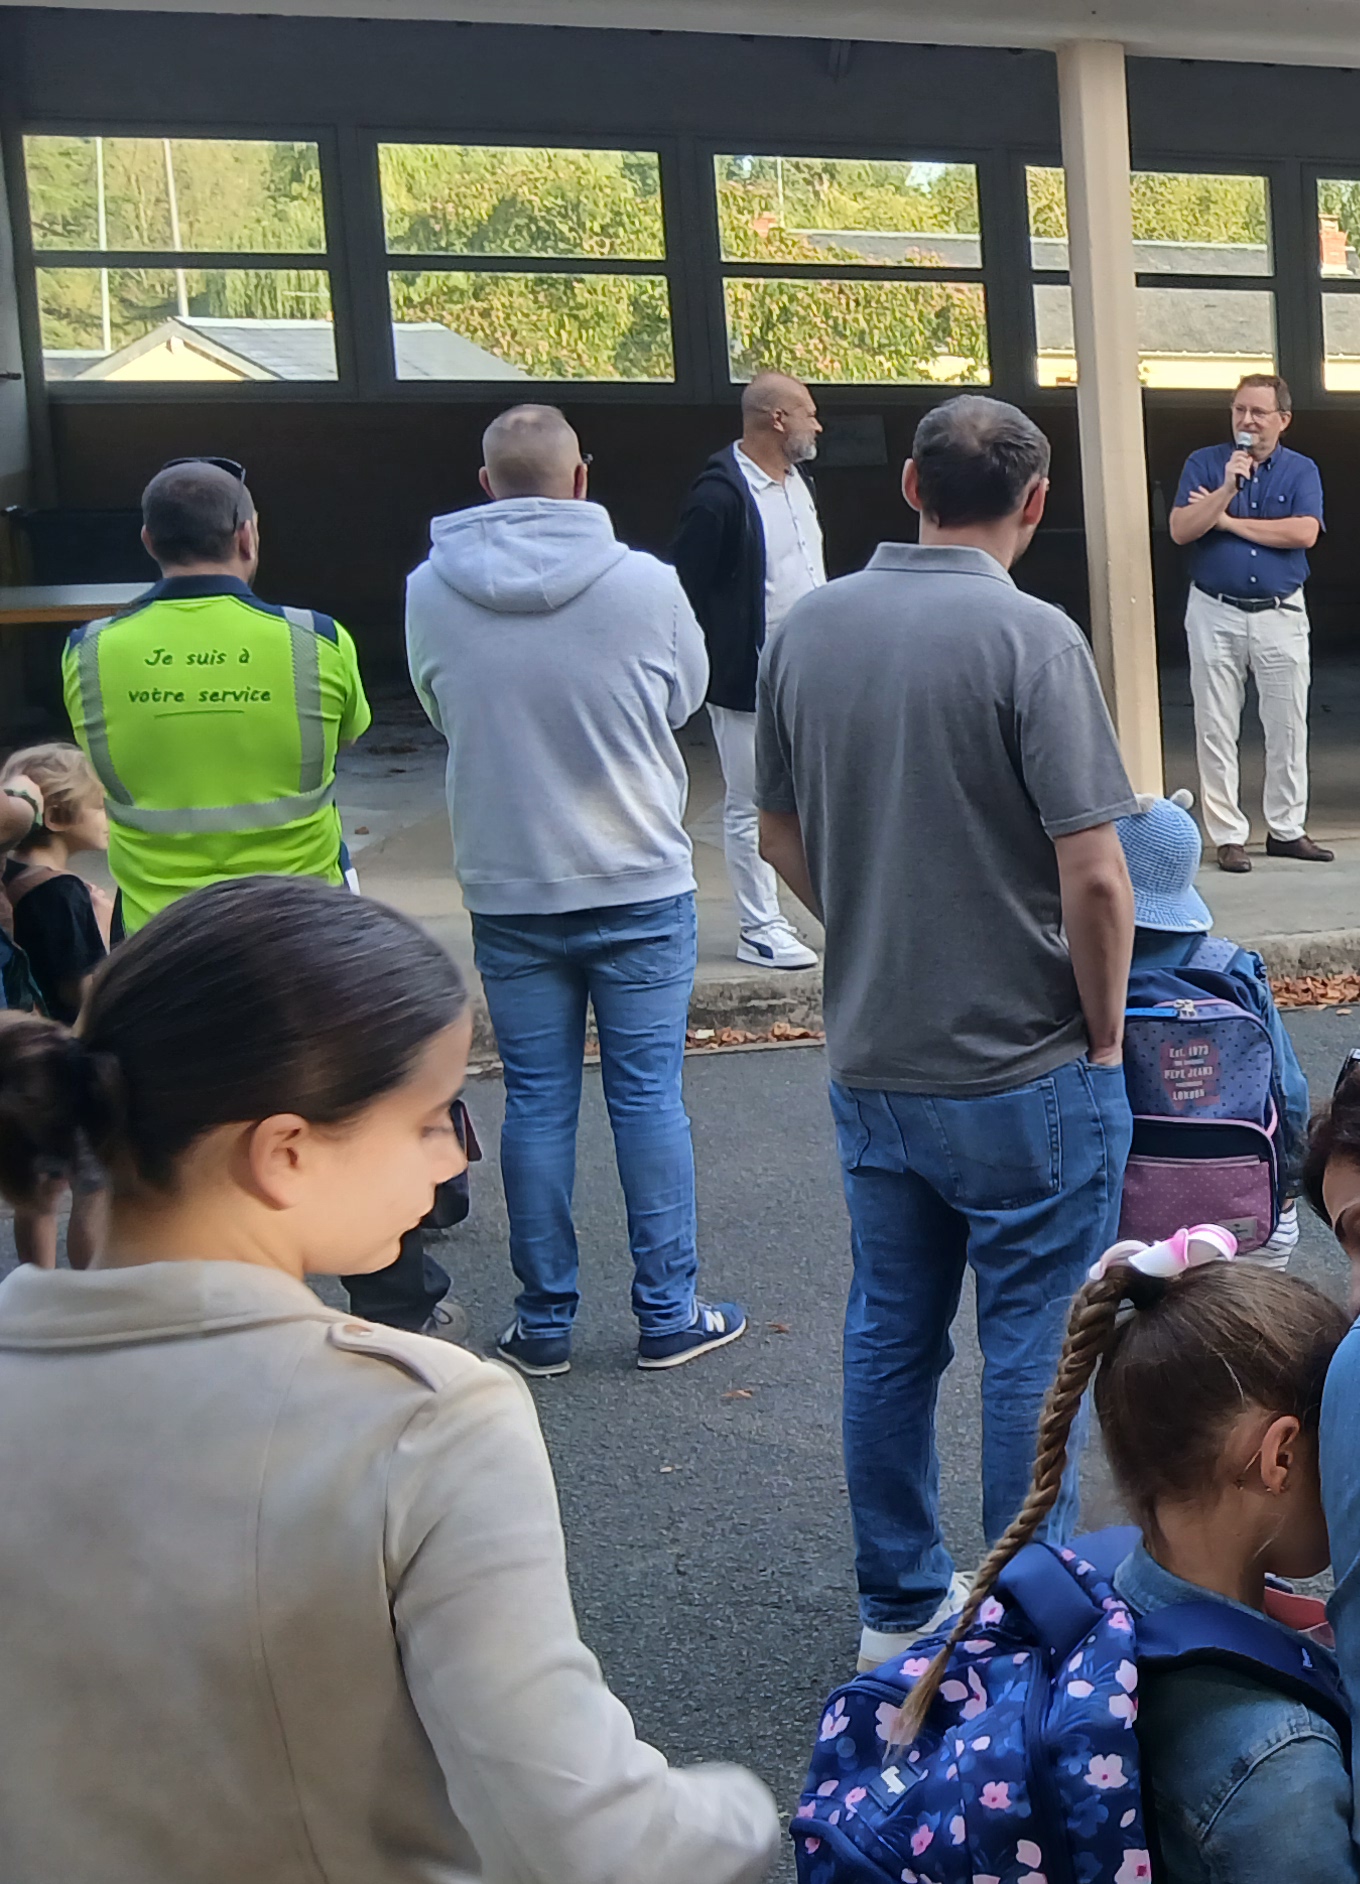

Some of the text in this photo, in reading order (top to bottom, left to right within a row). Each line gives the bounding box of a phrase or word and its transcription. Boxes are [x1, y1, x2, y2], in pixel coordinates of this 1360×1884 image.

[144, 647, 250, 666] Je suis à
[128, 686, 271, 703] votre service
[706, 1310, 725, 1332] N
